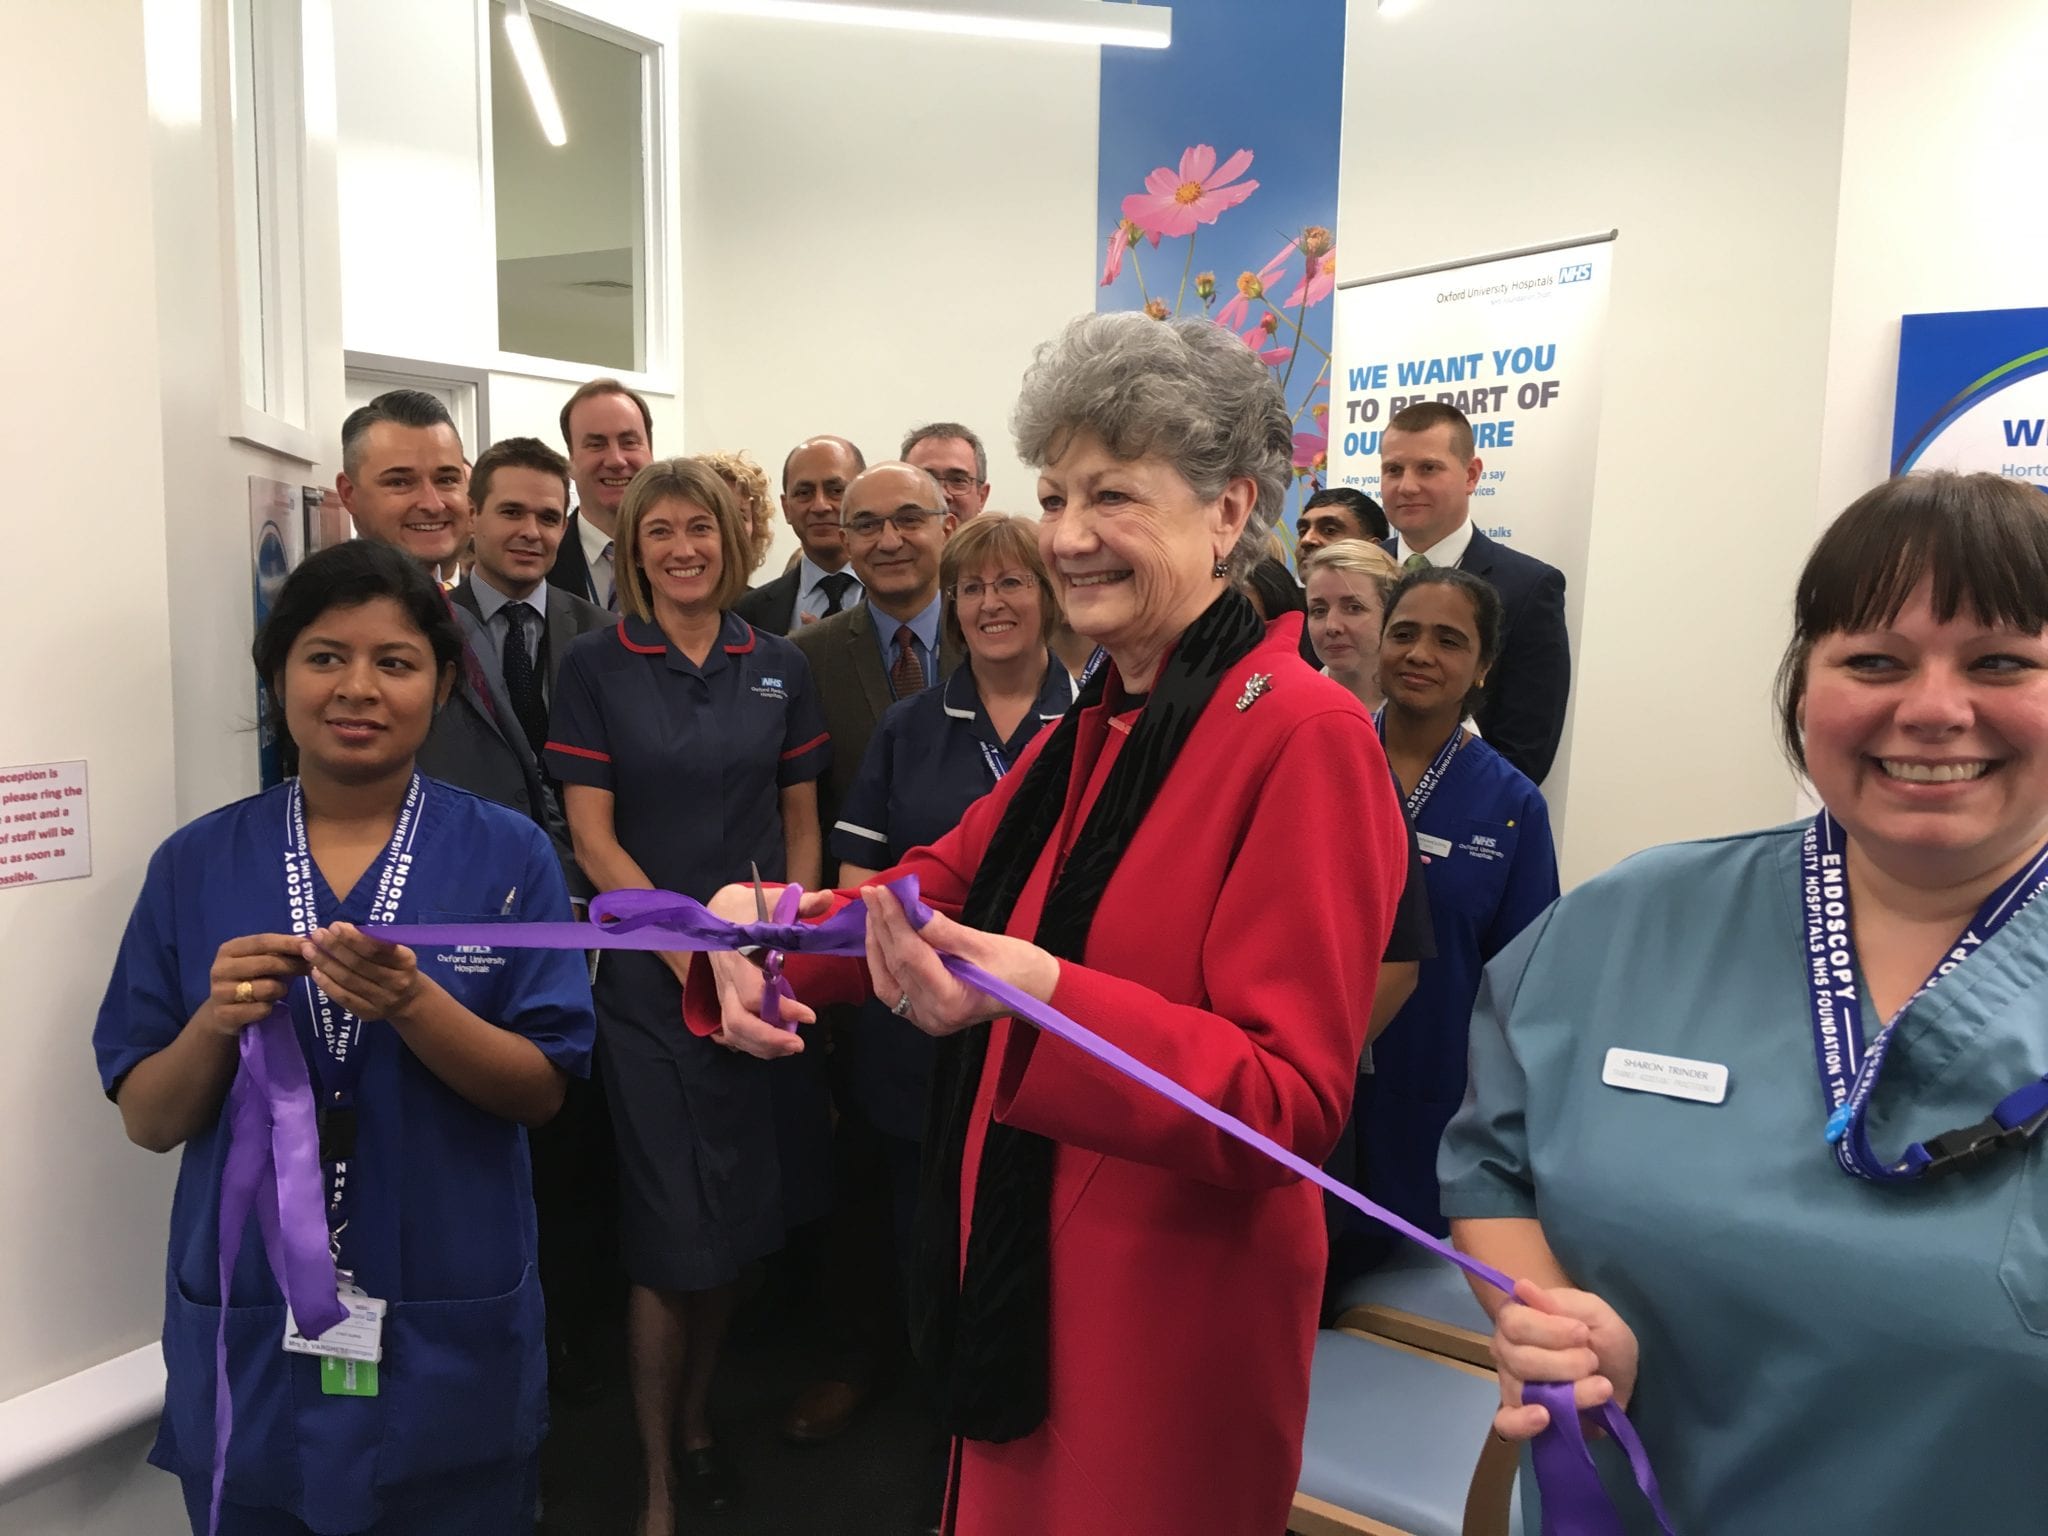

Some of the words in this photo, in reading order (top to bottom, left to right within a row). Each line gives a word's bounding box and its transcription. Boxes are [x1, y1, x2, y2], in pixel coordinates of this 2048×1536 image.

[1436, 288, 1466, 304] Oxford
[1467, 282, 1508, 298] University
[1511, 274, 1554, 290] Hospitals
[1558, 263, 1592, 284] NHS
[1348, 364, 1388, 392] WE
[1397, 353, 1483, 387] WANT
[1491, 344, 1556, 376] YOU
[1346, 398, 1380, 424] TO
[1517, 380, 1560, 410] OF
[1343, 431, 1384, 457] OU
[2003, 419, 2048, 447] W
[1345, 475, 1360, 485] Are
[1361, 475, 1380, 486] you
[1489, 470, 1506, 482] say
[1473, 485, 1496, 497] vices
[1488, 526, 1512, 538] talks
[761, 677, 783, 688] NHS
[0, 770, 46, 784] eception
[49, 769, 59, 779] is
[406, 773, 421, 808] OXFORD
[1407, 767, 1436, 809] OSCOPY
[2, 791, 38, 806] please
[40, 788, 62, 800] ring
[64, 786, 83, 797] the
[1410, 790, 1431, 820] OSPITALS
[5, 815, 11, 823] a
[14, 812, 37, 822] seat
[39, 807, 60, 819] and
[62, 808, 70, 817] a
[11, 830, 36, 843] staff
[38, 827, 59, 840] will
[60, 826, 75, 836] be
[387, 808, 412, 864] UNIVERSITY
[1471, 835, 1497, 849] NHS
[1803, 825, 1819, 871] ERSITY
[10, 855, 22, 863] as
[25, 851, 51, 861] soon
[53, 848, 66, 857] as
[300, 858, 311, 880] NHS
[0, 871, 38, 885] ossible.
[381, 853, 413, 927] ENDOSC
[284, 851, 307, 938] DOSCOPY
[369, 864, 395, 921] HOSPITALS
[302, 881, 318, 935] OSPITALS
[1804, 875, 1826, 953] HOSPITALS
[1821, 853, 1856, 1000] ENDOSCOPY
[436, 953, 467, 964] Oxford
[469, 954, 506, 966] University
[454, 964, 490, 974] Hospitals
[1811, 956, 1830, 986] NHS
[334, 1024, 352, 1063] TRUST
[1816, 989, 1842, 1076] FOUNDATION
[1623, 1058, 1664, 1073] SHARON
[1667, 1065, 1709, 1081] TRINDER
